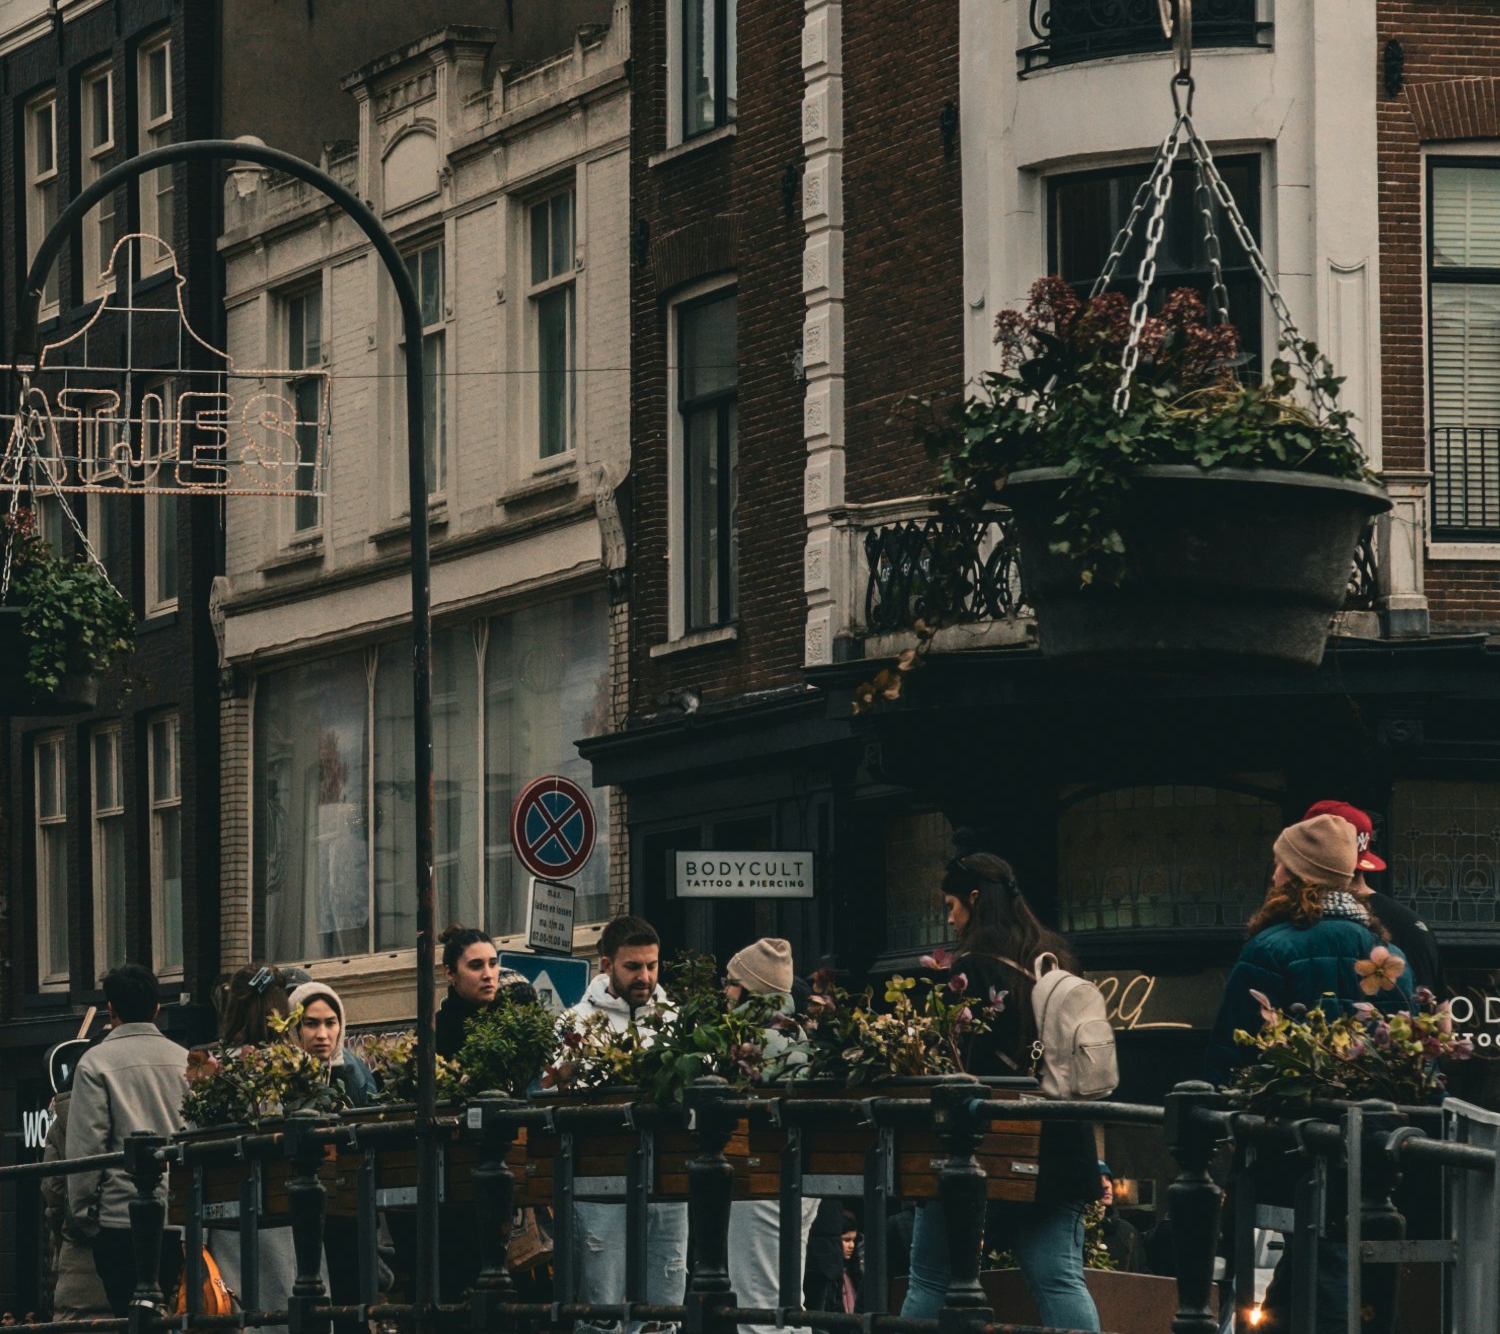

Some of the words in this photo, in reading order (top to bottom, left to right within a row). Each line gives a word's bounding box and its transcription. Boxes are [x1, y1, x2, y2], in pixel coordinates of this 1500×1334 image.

[686, 861, 804, 876] BODYCULT
[686, 879, 732, 888] TATTOO
[737, 879, 744, 888] &
[750, 879, 805, 888] PIERCING
